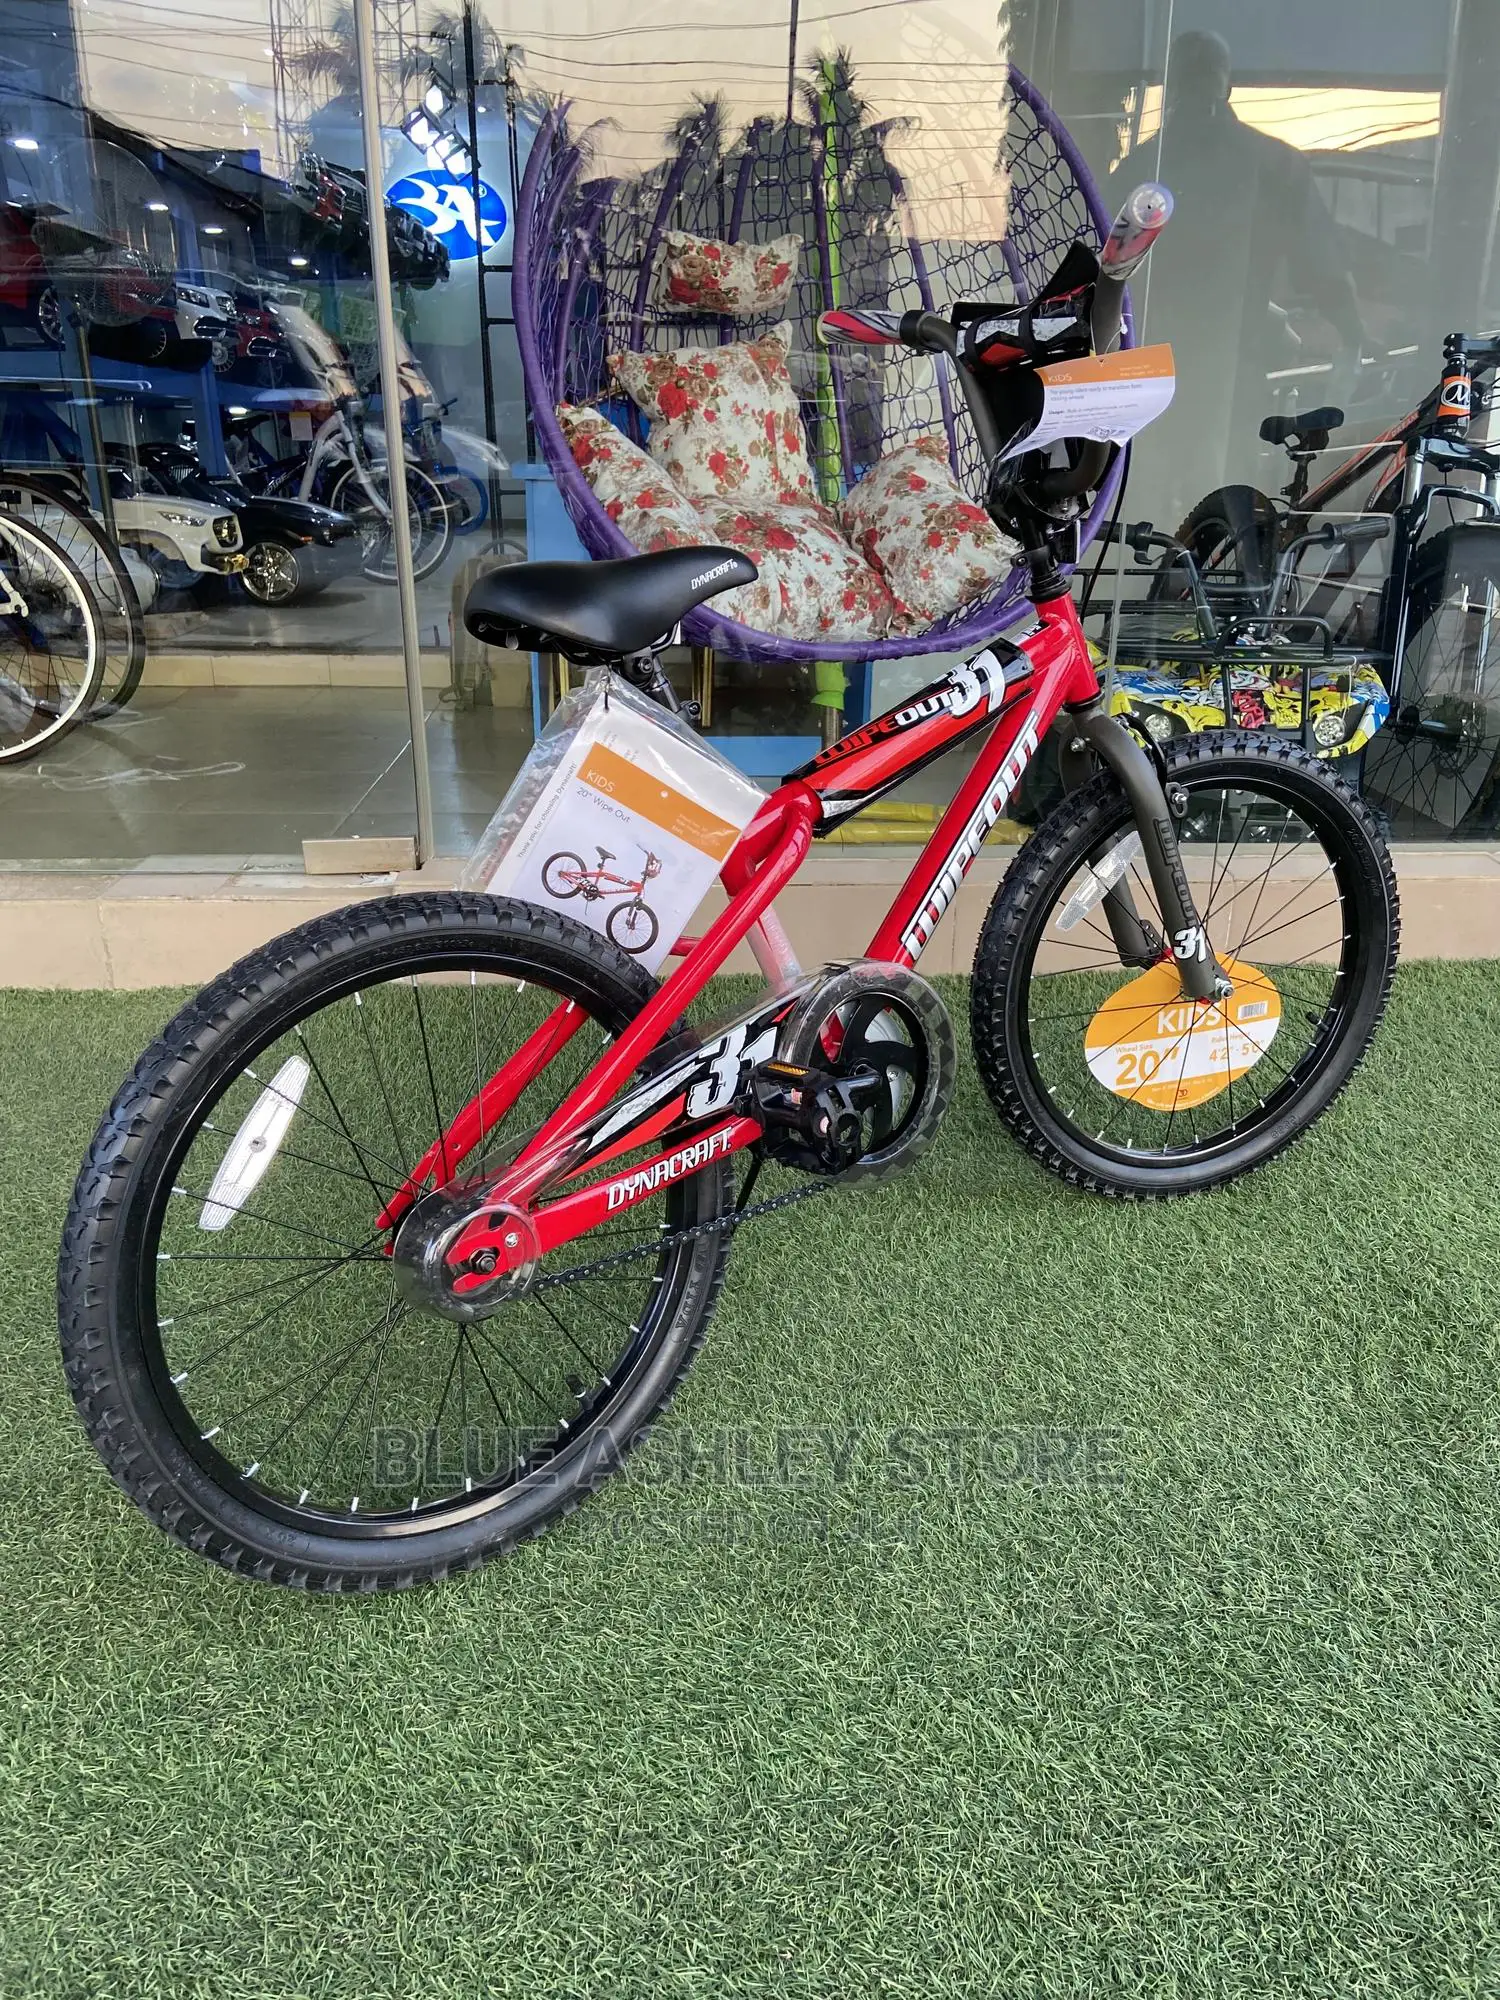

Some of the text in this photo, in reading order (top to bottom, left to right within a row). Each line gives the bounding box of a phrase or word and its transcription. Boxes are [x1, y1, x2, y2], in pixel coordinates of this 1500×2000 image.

[586, 769, 616, 793] KIDS
[593, 797, 613, 815] Wipe
[614, 808, 632, 824] Out
[1173, 926, 1207, 963] 31
[1156, 1003, 1222, 1035] KIDS
